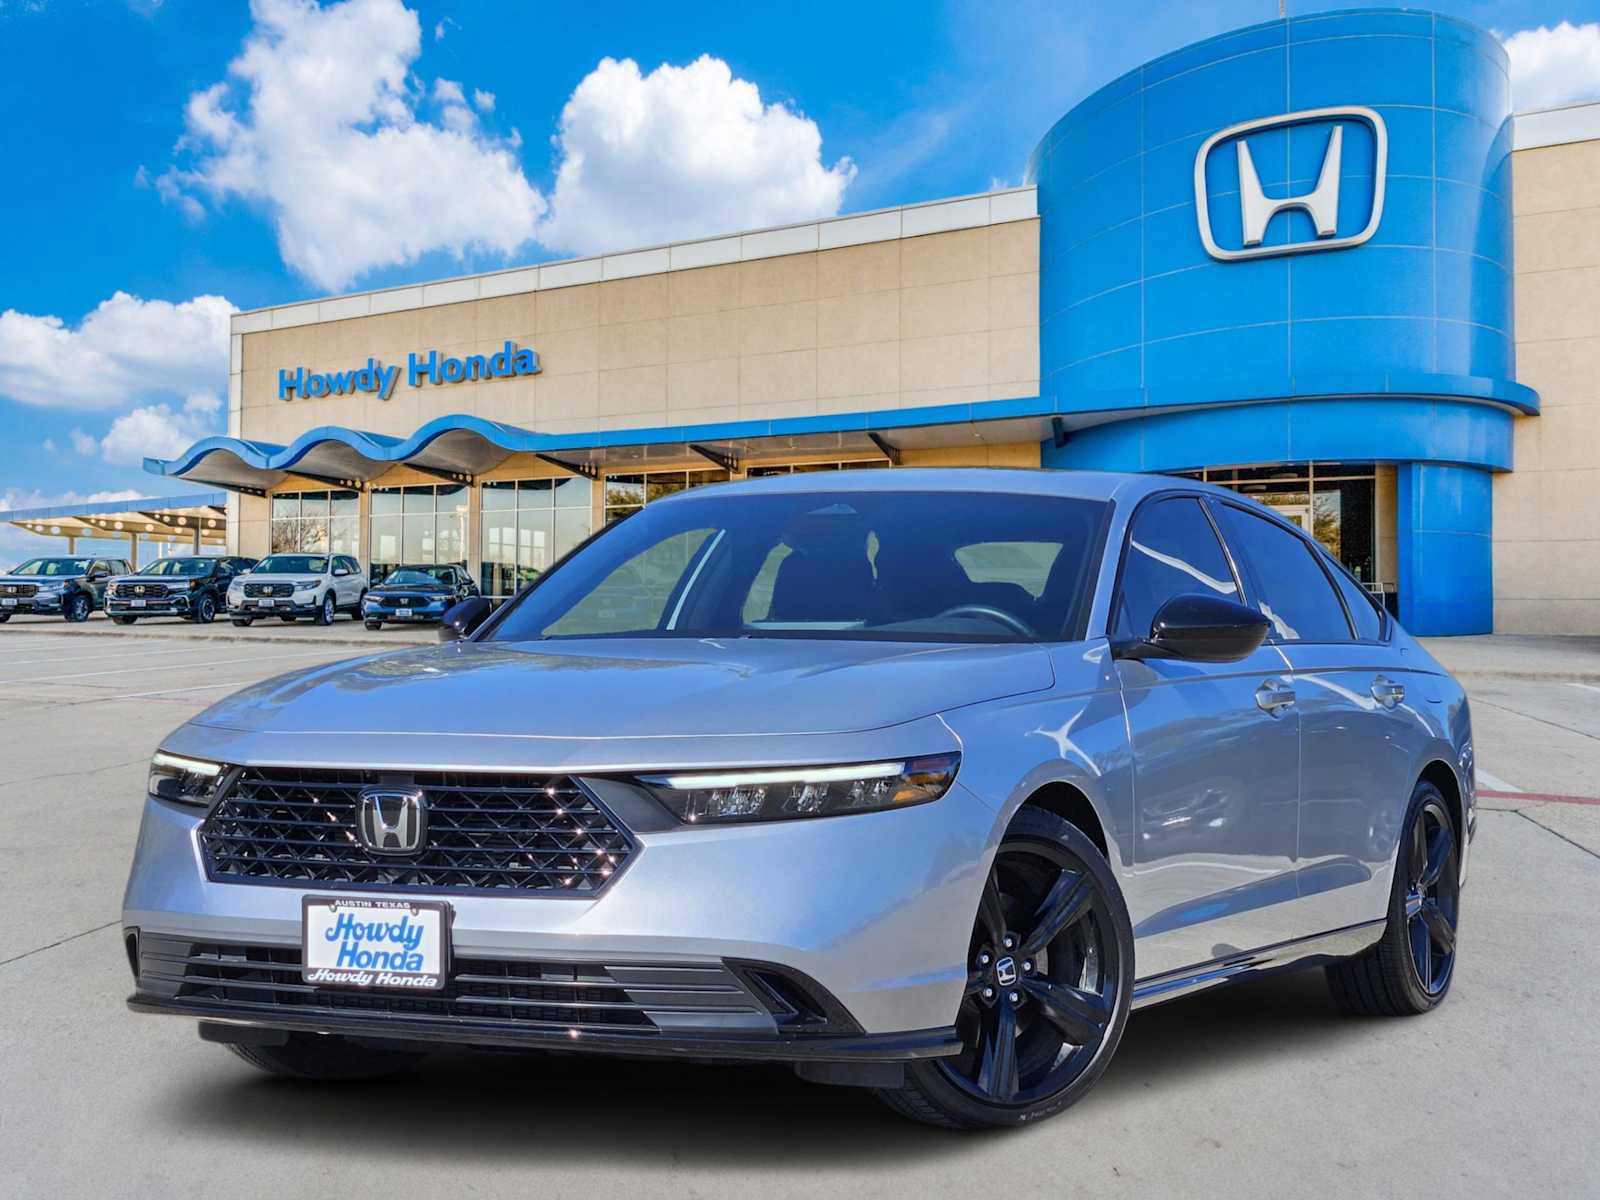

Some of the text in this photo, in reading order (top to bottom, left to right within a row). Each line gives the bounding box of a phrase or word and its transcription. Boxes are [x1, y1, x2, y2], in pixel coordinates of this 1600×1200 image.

[278, 340, 542, 401] Howdy Honda
[334, 900, 411, 909] AUSTIN TEXAS
[325, 913, 424, 951] Howdy
[336, 942, 424, 971] Honda
[307, 969, 438, 987] Howdy Honda
